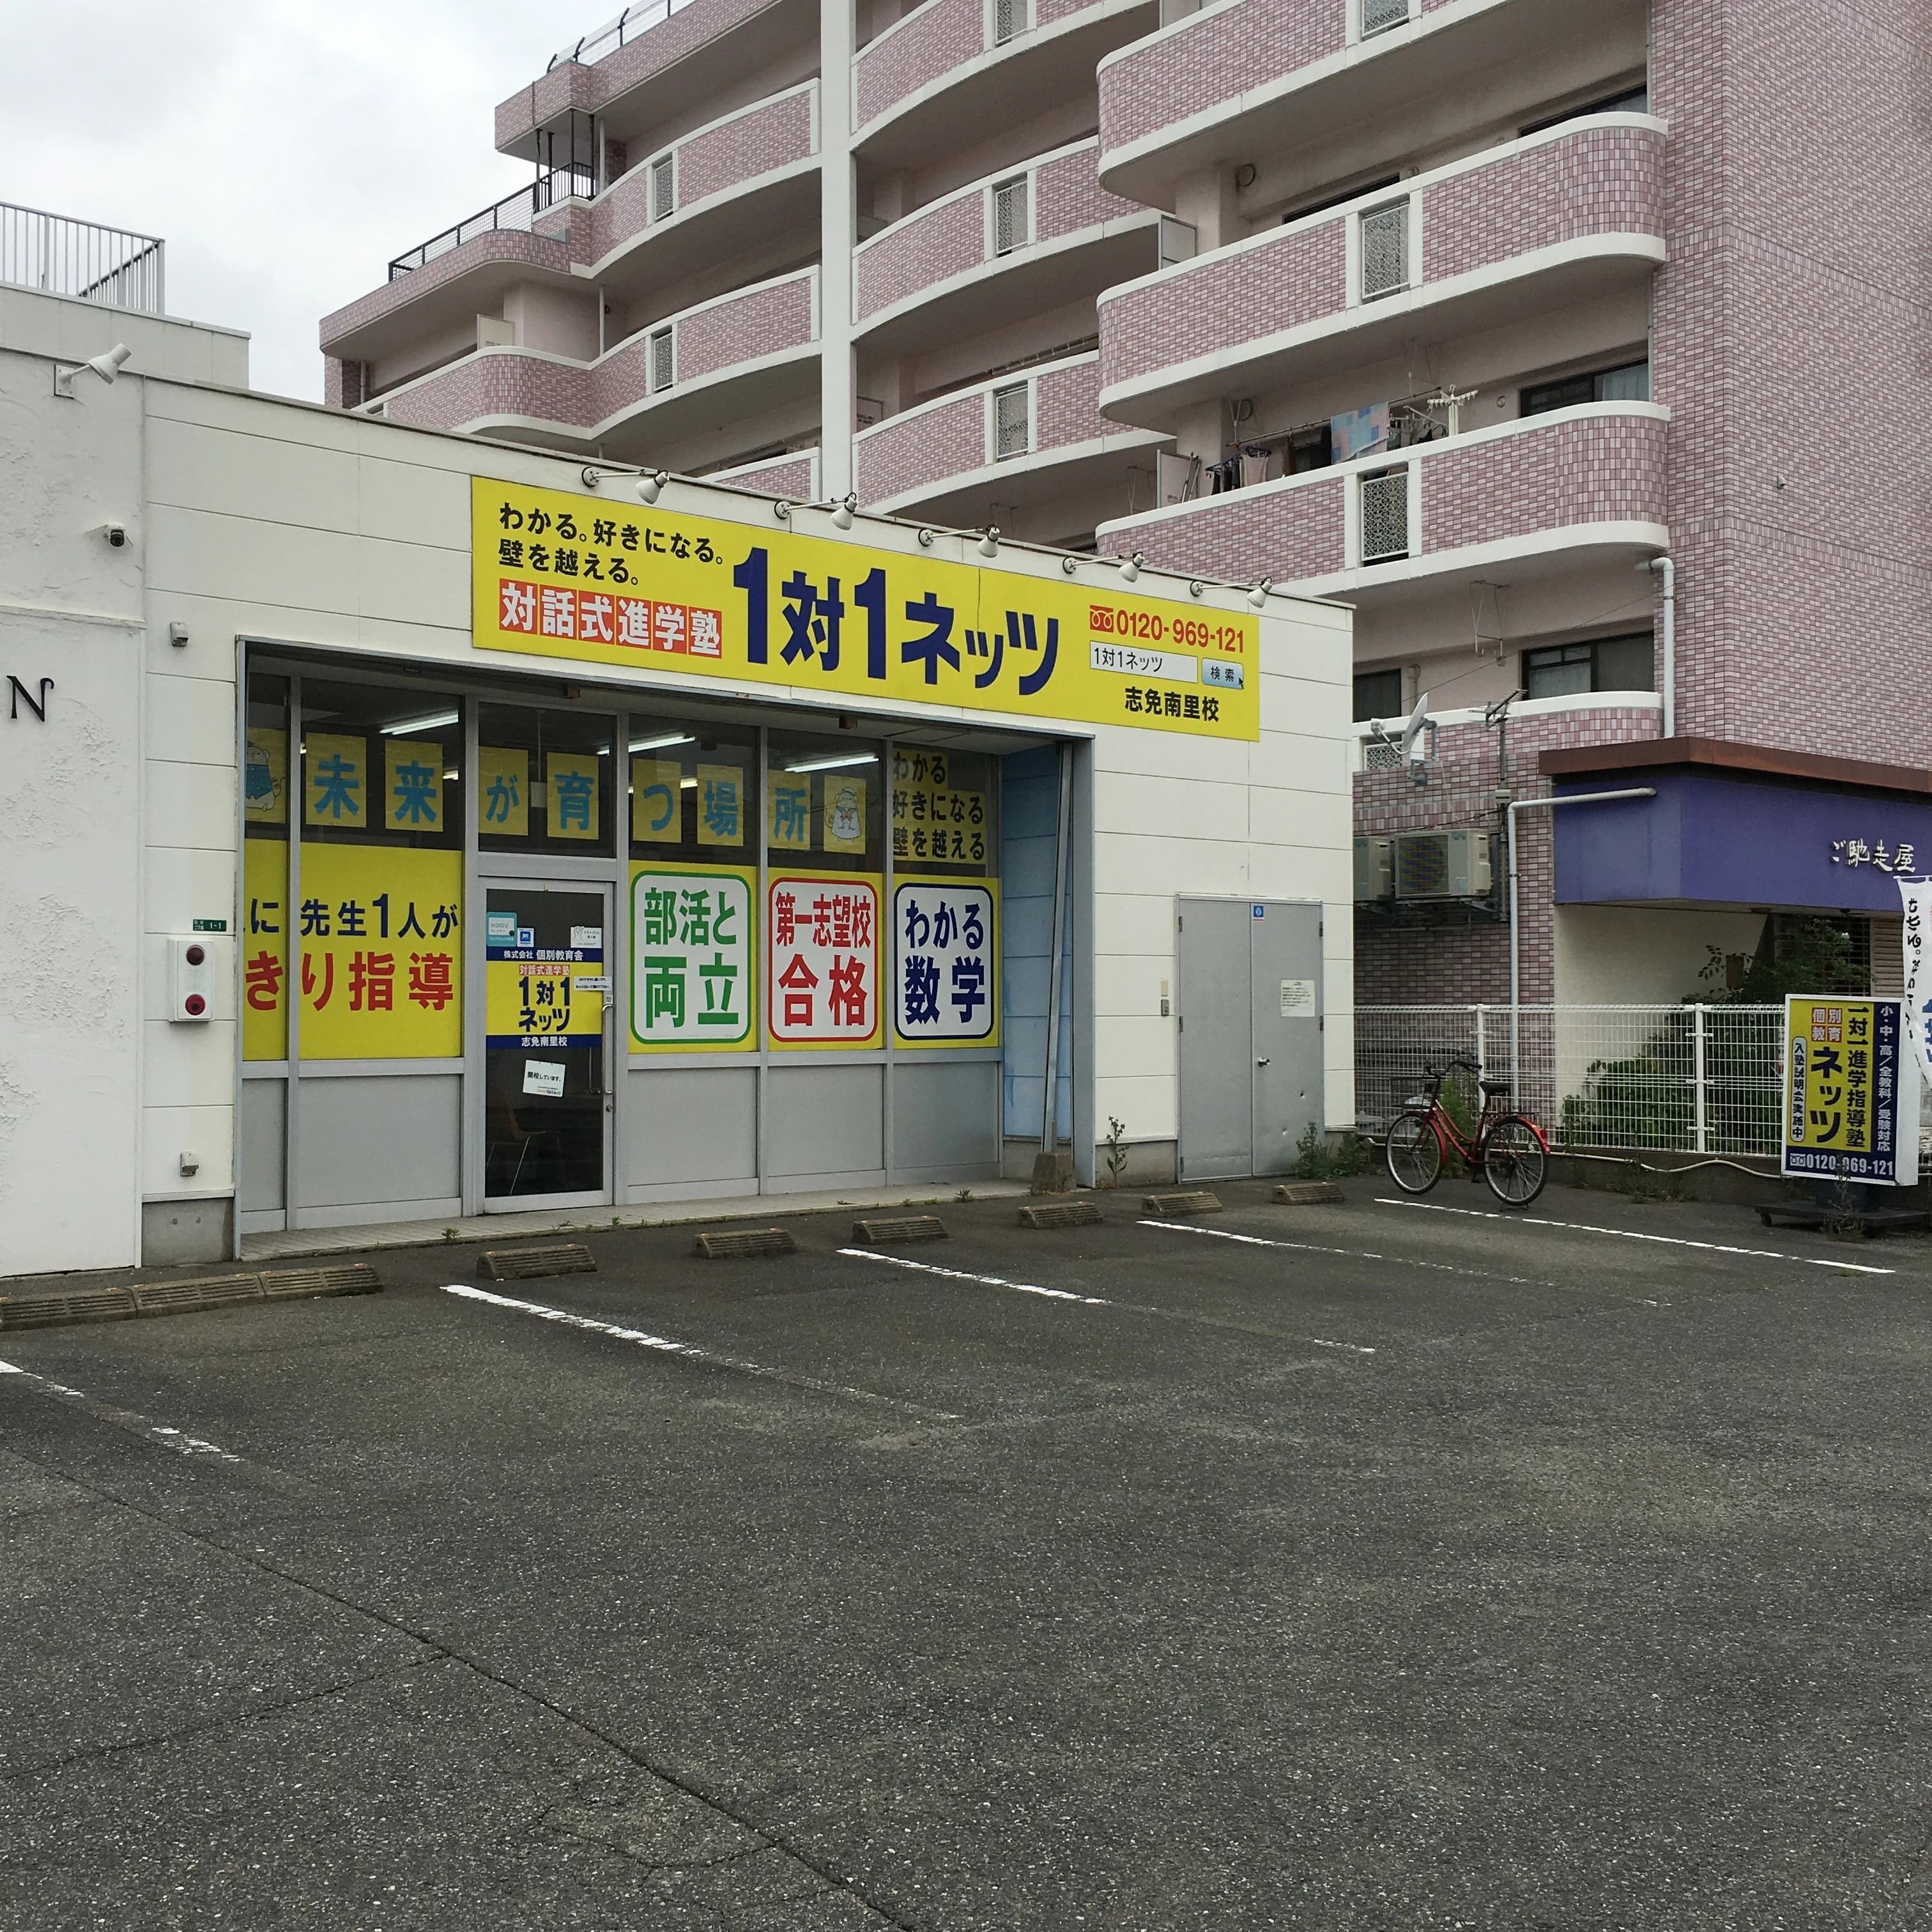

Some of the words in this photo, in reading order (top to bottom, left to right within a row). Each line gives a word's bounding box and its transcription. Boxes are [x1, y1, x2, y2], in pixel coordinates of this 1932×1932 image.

[499, 502, 723, 565] わかる。好きになる。
[498, 538, 639, 586] 壁を越える。
[501, 580, 721, 658] 対話式進学塾
[733, 547, 1059, 696] 1対1ネッツ
[1116, 609, 1244, 653] 0120-969-121
[1094, 647, 1163, 672] 1対1ネッツ
[1211, 666, 1235, 682] 検索
[6, 675, 55, 723] N
[1124, 686, 1220, 722] 志免南里校
[893, 751, 946, 785] わかる
[893, 789, 984, 825] 好きになる
[893, 827, 985, 861] 壁を越える
[1830, 838, 1916, 873] ご馳走屋
[643, 887, 738, 947] 部活と
[775, 891, 872, 949] 第一志望校
[905, 899, 985, 950] わかる
[503, 949, 533, 959] 株式会社
[519, 965, 570, 976] 対話式進学塾
[519, 976, 571, 1006] 1対1
[644, 953, 739, 1029] 両立
[778, 953, 868, 1027] 合格
[905, 955, 986, 1025] 数学
[519, 1007, 571, 1032] ネッツ
[1812, 1008, 1842, 1023] 個別
[1812, 1026, 1842, 1041] 教育
[521, 1036, 568, 1046] 志免南里校
[1809, 1046, 1843, 1143] ネッツ
